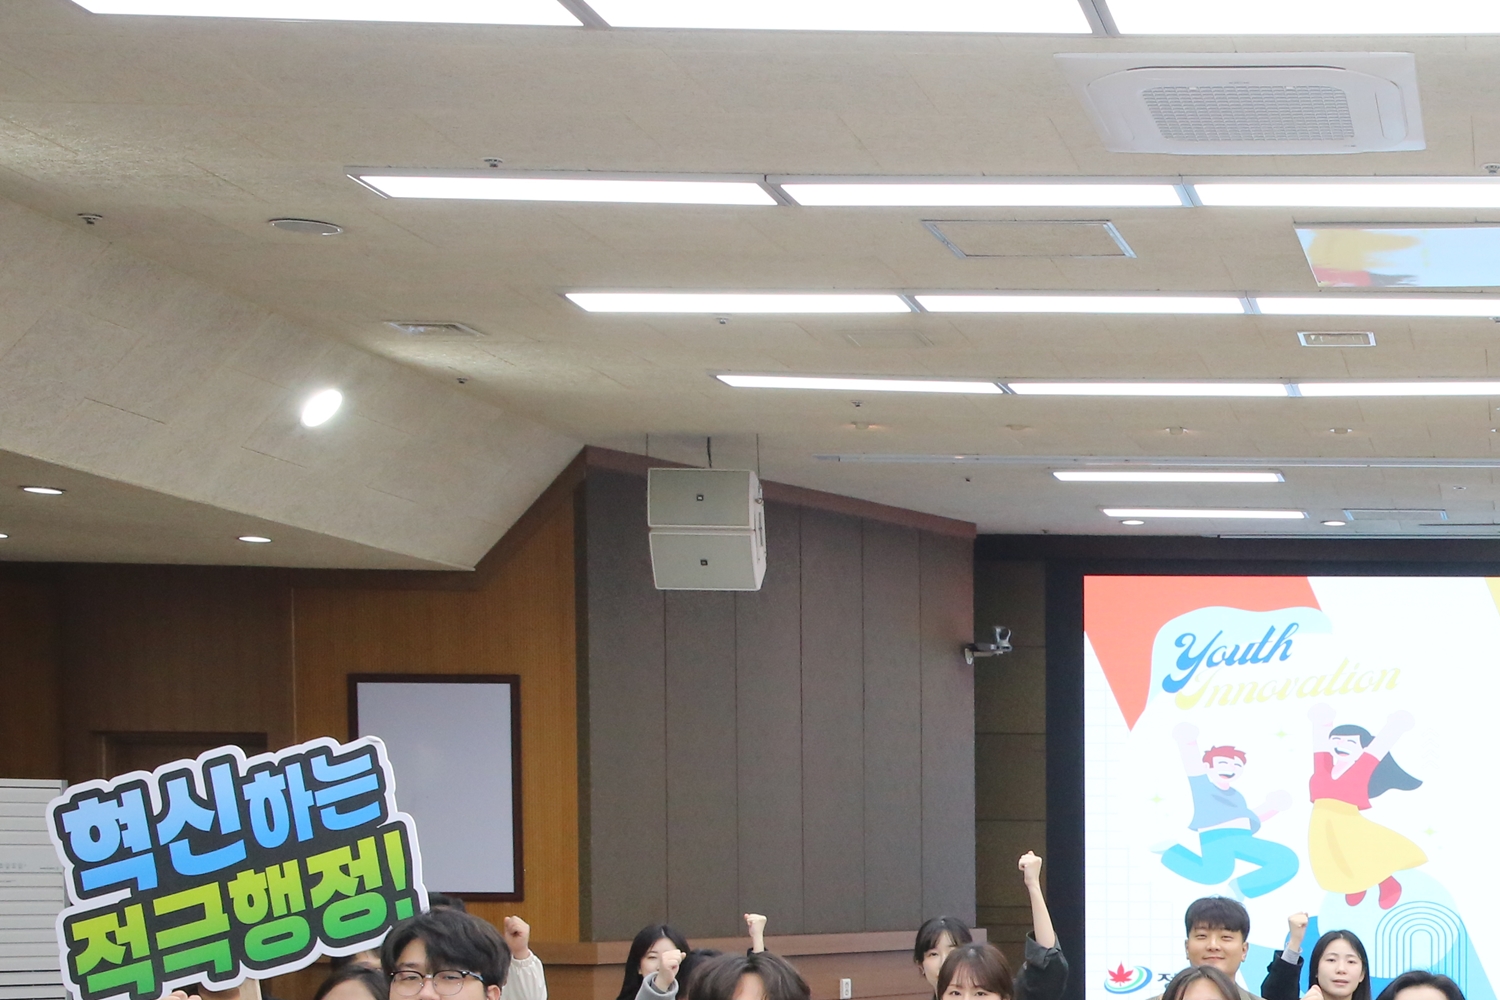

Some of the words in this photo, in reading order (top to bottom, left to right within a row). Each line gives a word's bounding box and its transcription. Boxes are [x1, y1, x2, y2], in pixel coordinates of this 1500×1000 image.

[1161, 622, 1300, 694] Youth
[1174, 657, 1401, 711] Innovation
[61, 753, 383, 892] 혁신하는
[69, 830, 416, 997] 적극행정!
